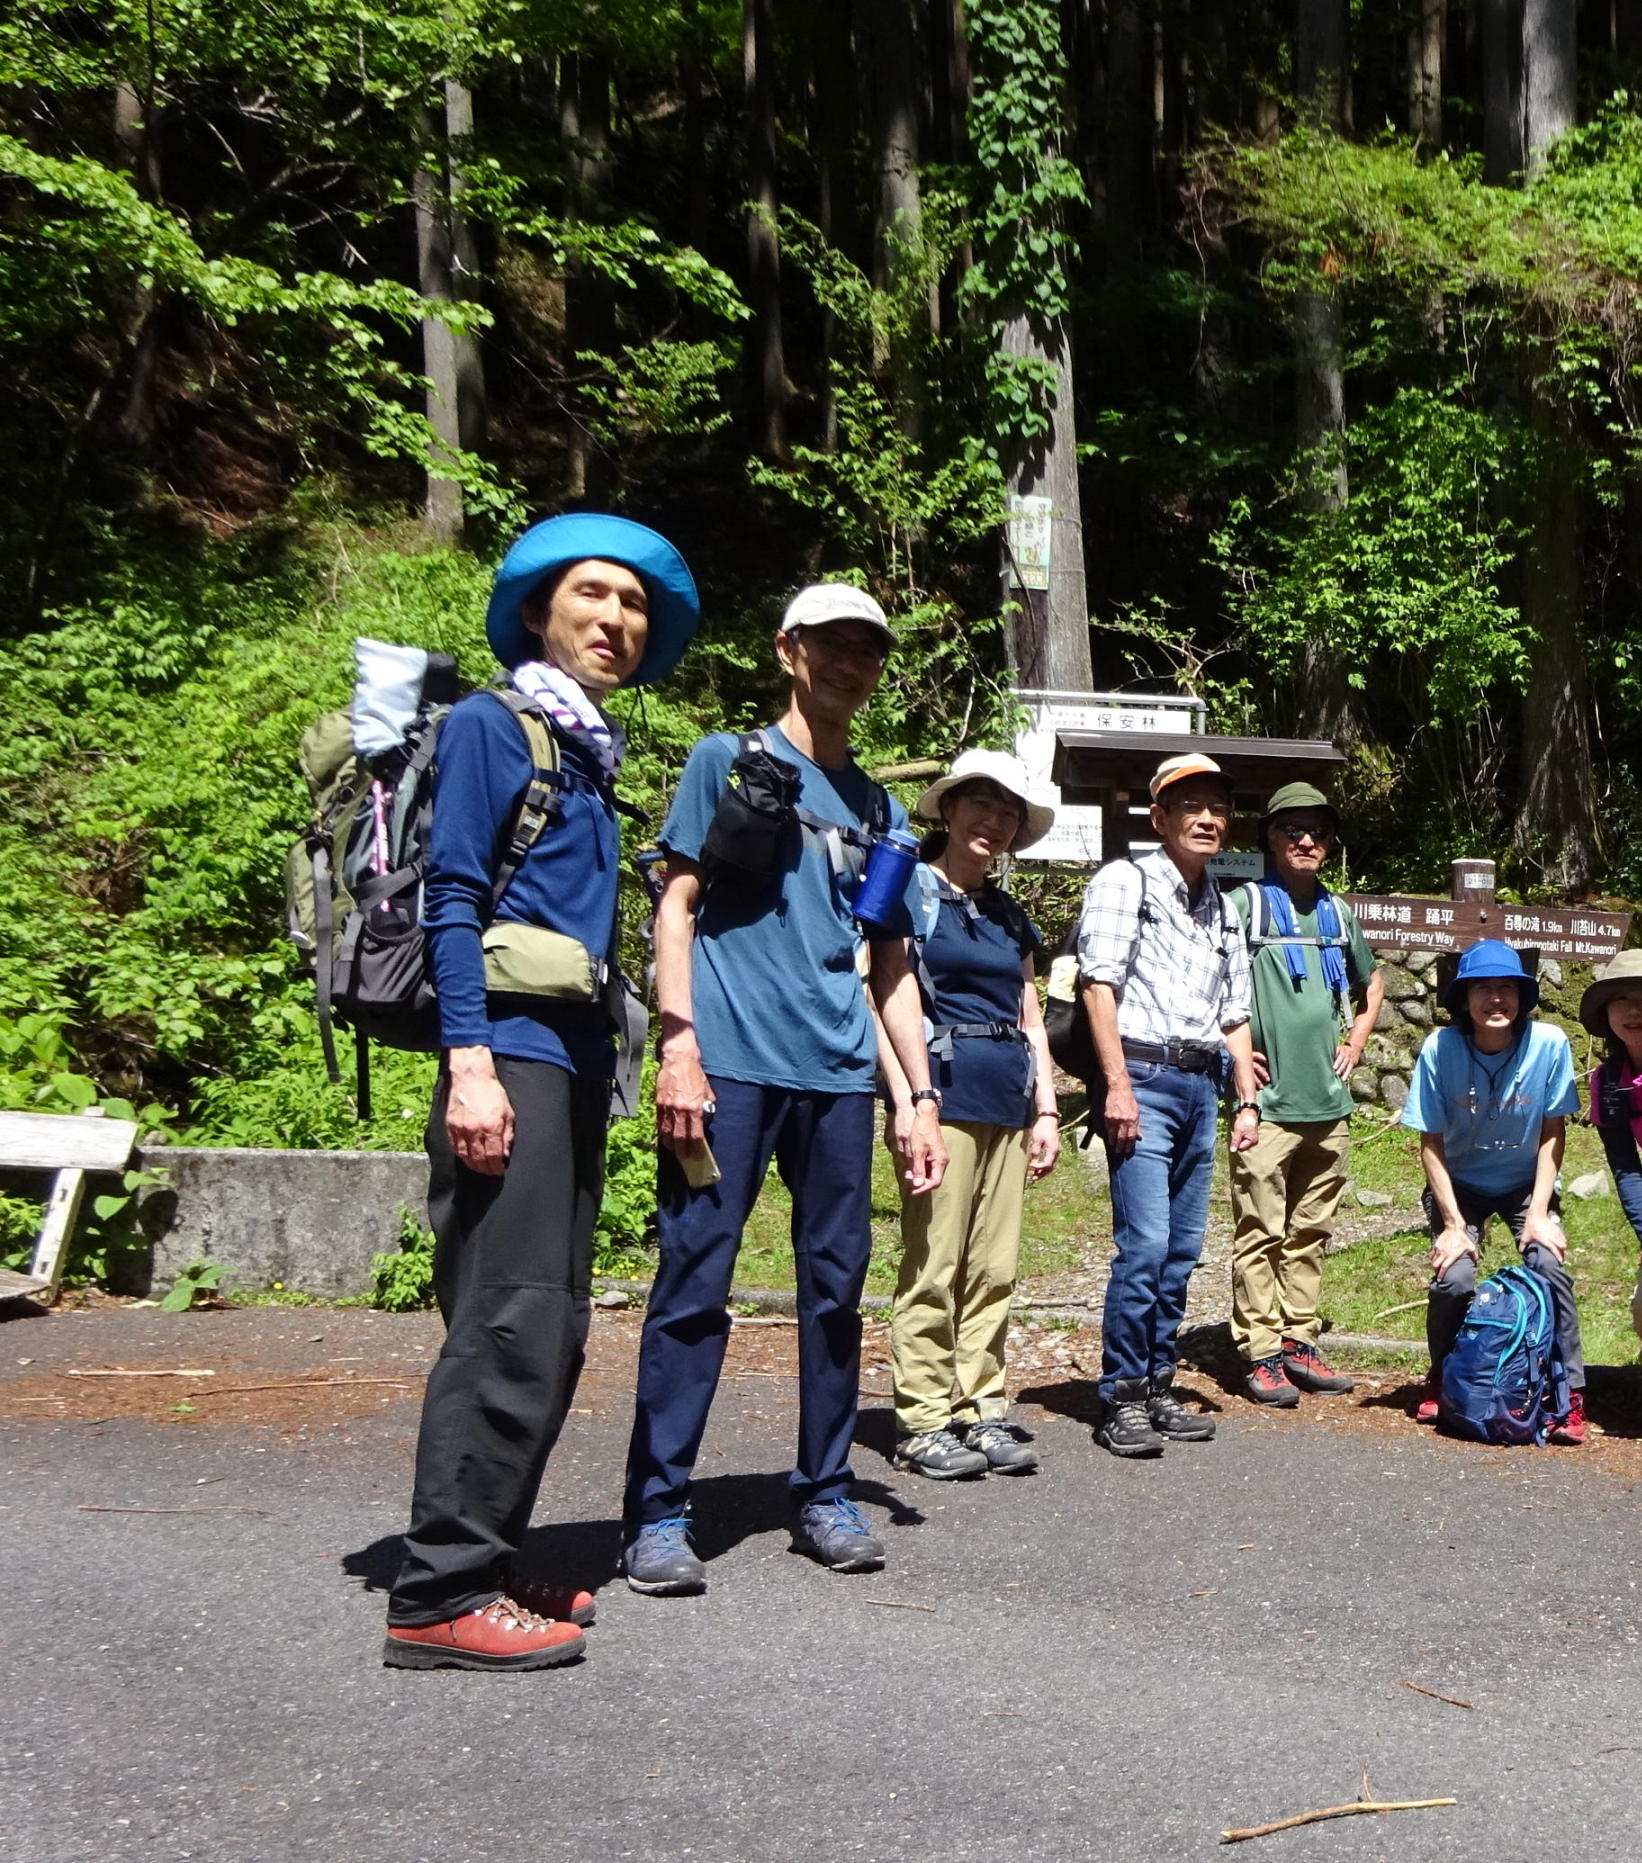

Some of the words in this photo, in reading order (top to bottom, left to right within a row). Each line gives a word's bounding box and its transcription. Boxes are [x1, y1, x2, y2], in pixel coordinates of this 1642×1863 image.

[1097, 713, 1157, 730] 保安林
[1353, 902, 1412, 924] 川乗林道
[1425, 908, 1455, 926] 踊平
[1504, 914, 1540, 933] 百尋の滝
[1542, 920, 1563, 933] 1.9km
[1570, 919, 1597, 936] 川苔山
[1597, 925, 1621, 937] 4.7km
[1362, 928, 1394, 941] wanori
[1395, 929, 1433, 945] Forestry
[1435, 931, 1455, 947] Way
[1560, 940, 1573, 953] Fall
[1575, 941, 1617, 955] Mt.Kawanori
